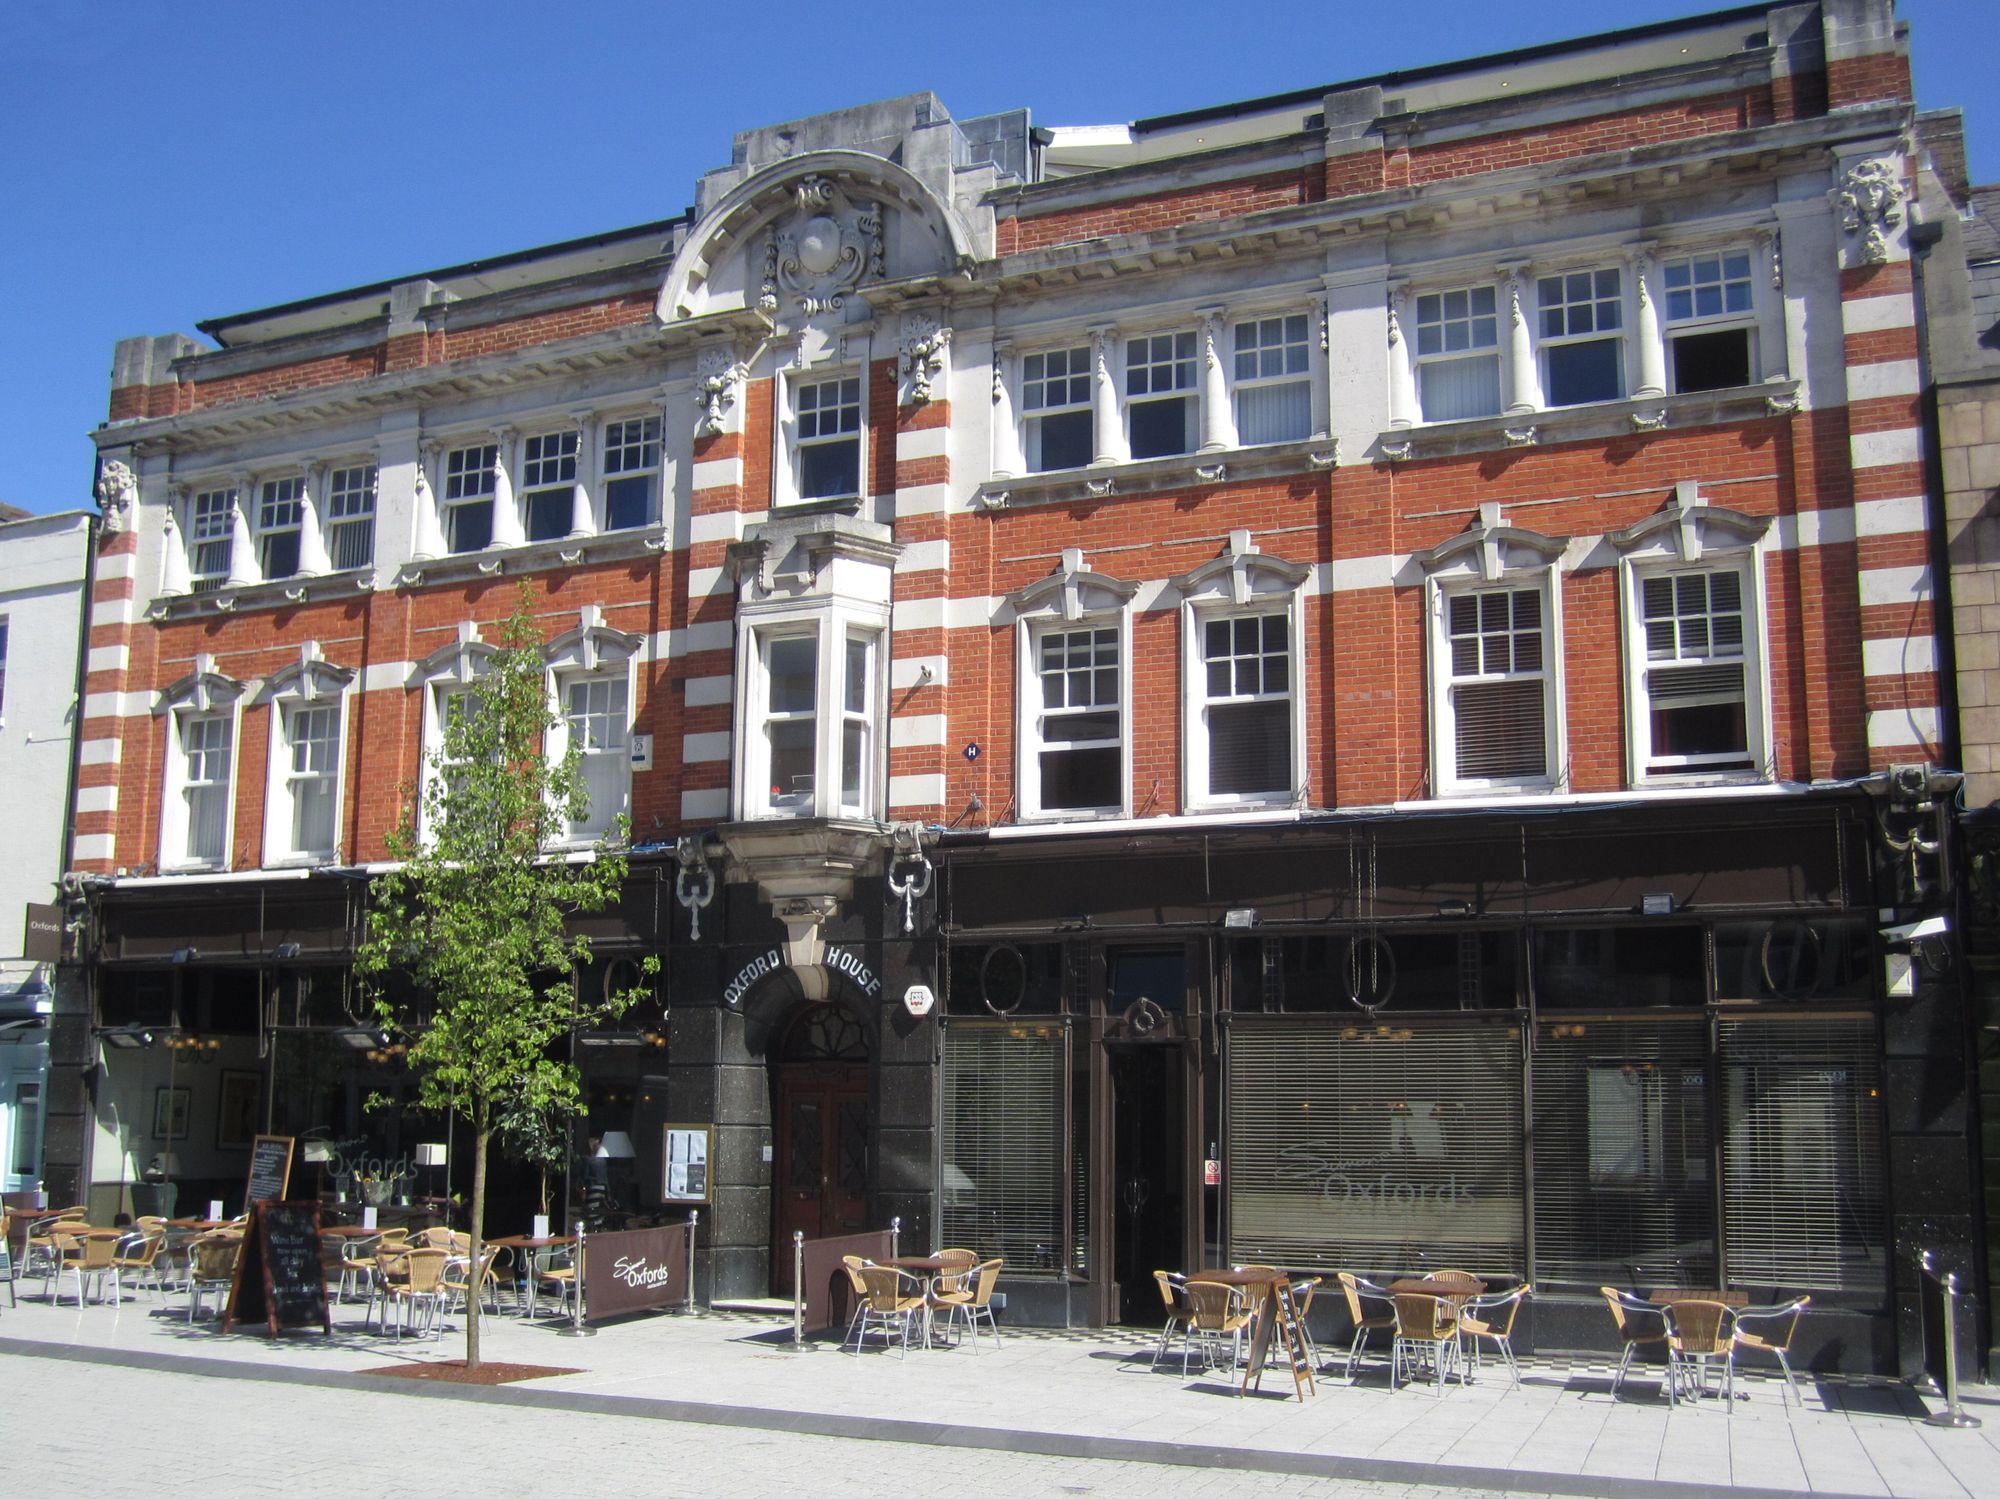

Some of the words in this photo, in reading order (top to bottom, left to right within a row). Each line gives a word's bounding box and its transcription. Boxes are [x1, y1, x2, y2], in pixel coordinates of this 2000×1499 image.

[968, 747, 976, 756] H
[31, 921, 60, 932] Oxfords
[723, 950, 780, 1004] OXFORD
[827, 946, 881, 996] HOUSE
[326, 1151, 419, 1179] Oxfords
[1324, 1172, 1477, 1209] Oxfords
[628, 1264, 668, 1287] Oxfords
